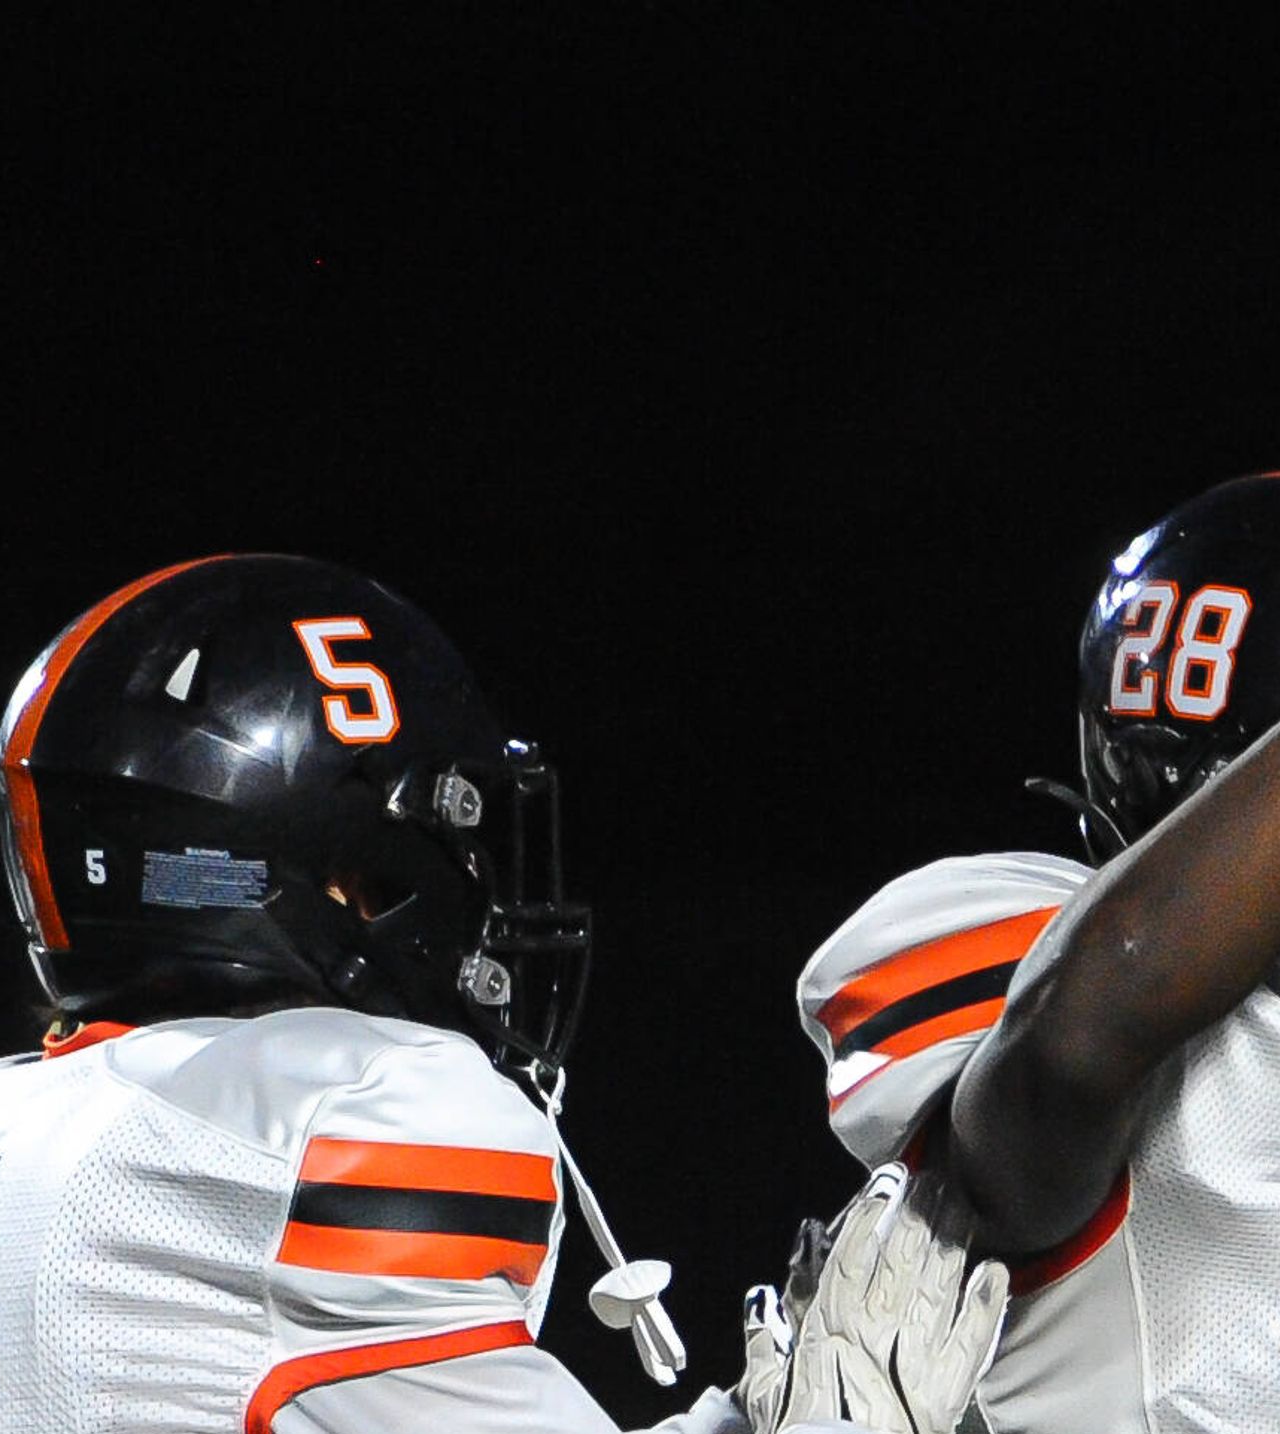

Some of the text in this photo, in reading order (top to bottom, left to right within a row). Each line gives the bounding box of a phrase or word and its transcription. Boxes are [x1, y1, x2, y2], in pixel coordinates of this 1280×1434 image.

[293, 616, 401, 745] 5
[1109, 579, 1253, 723] 28
[85, 849, 107, 885] 5
